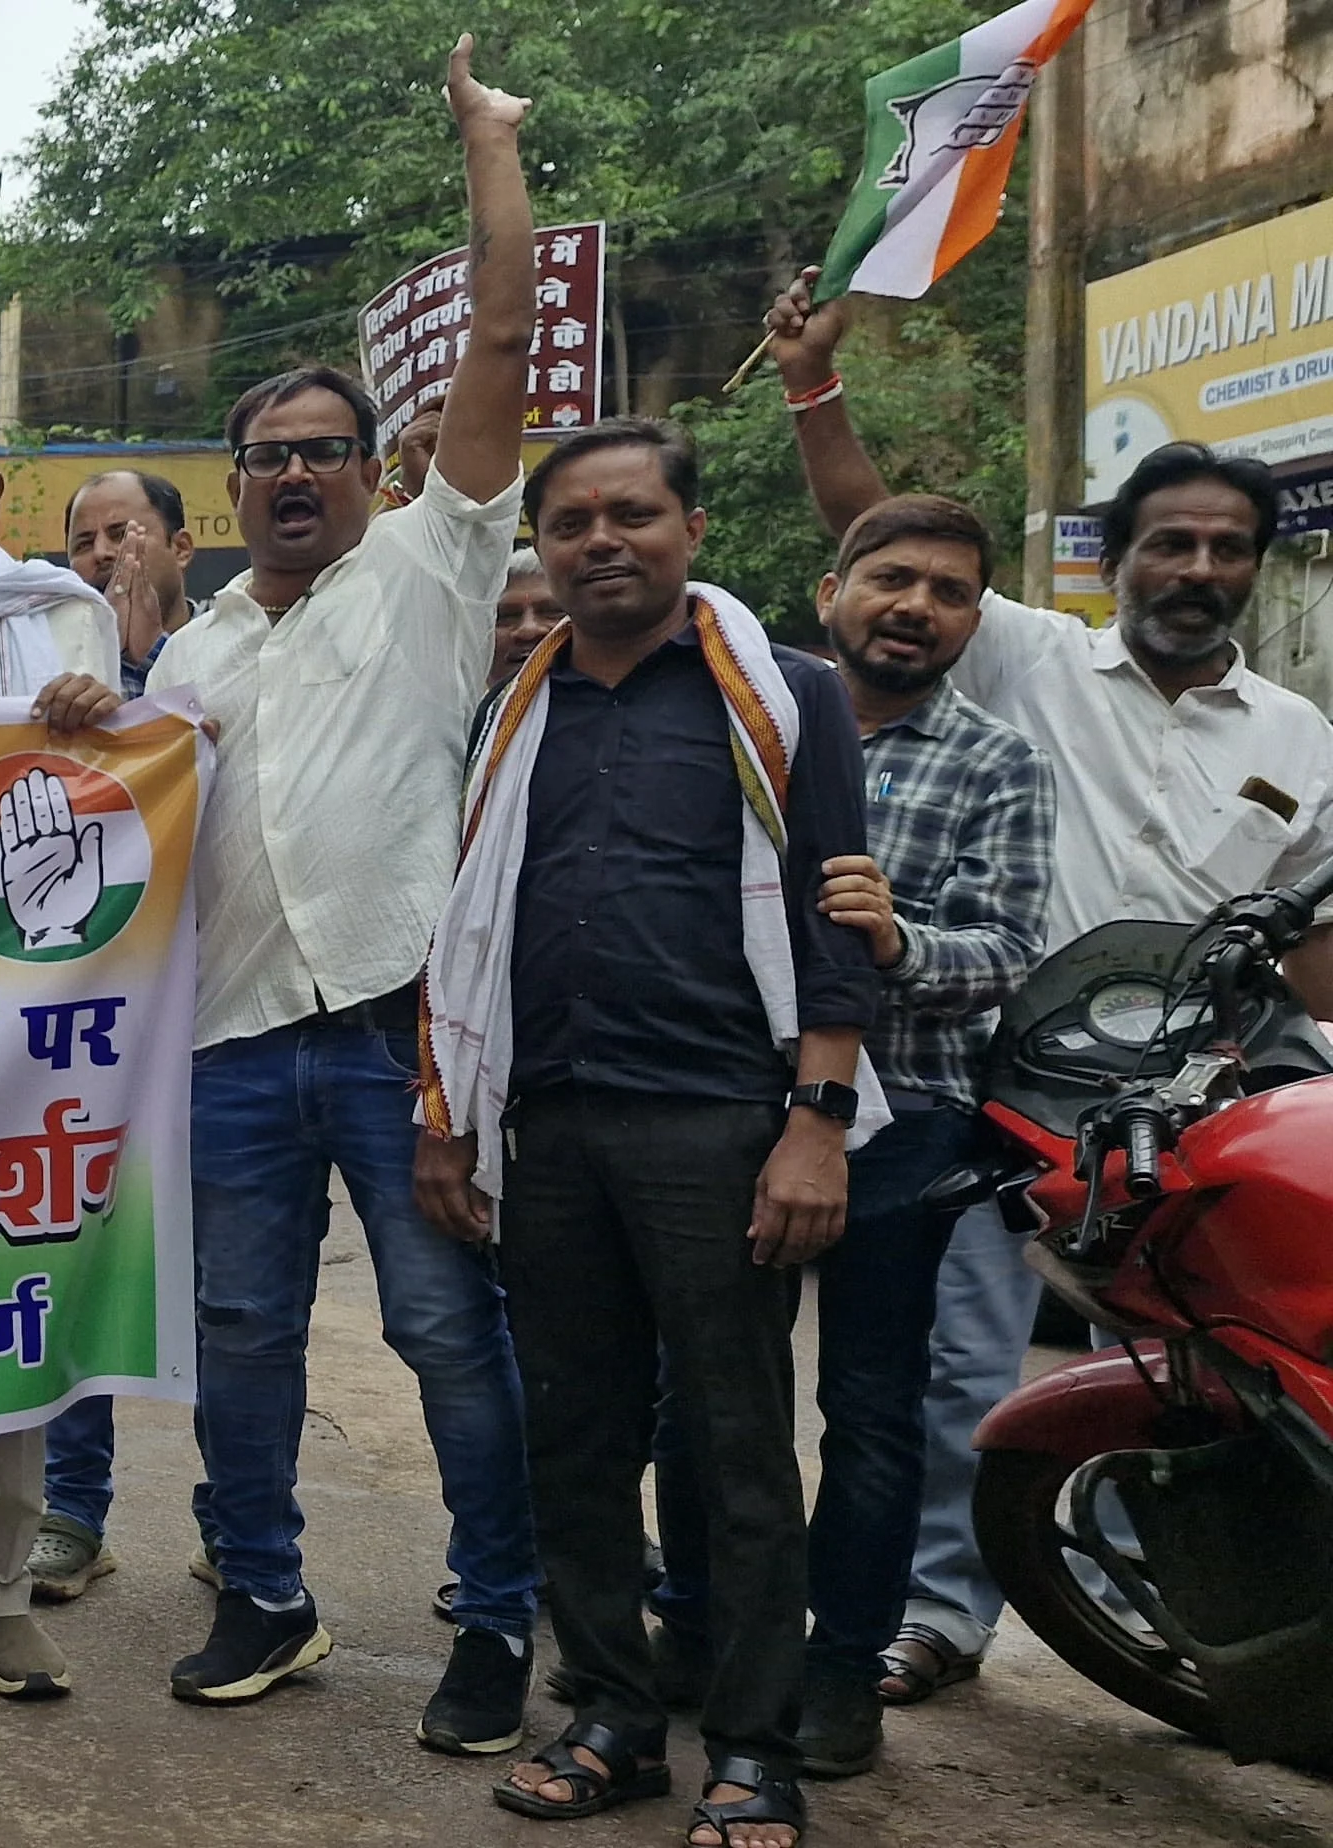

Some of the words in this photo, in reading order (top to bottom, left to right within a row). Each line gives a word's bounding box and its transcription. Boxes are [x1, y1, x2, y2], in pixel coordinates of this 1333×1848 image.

[364, 283, 412, 342] दिल्ली
[414, 265, 471, 302] जंतर
[550, 233, 583, 267] में
[416, 336, 450, 373] की
[550, 316, 588, 350] के
[1097, 273, 1277, 387] VANDANA
[547, 359, 585, 393] हो
[1204, 370, 1275, 407] CHEMIST
[1278, 367, 1291, 387] &
[20, 996, 126, 1070] पर
